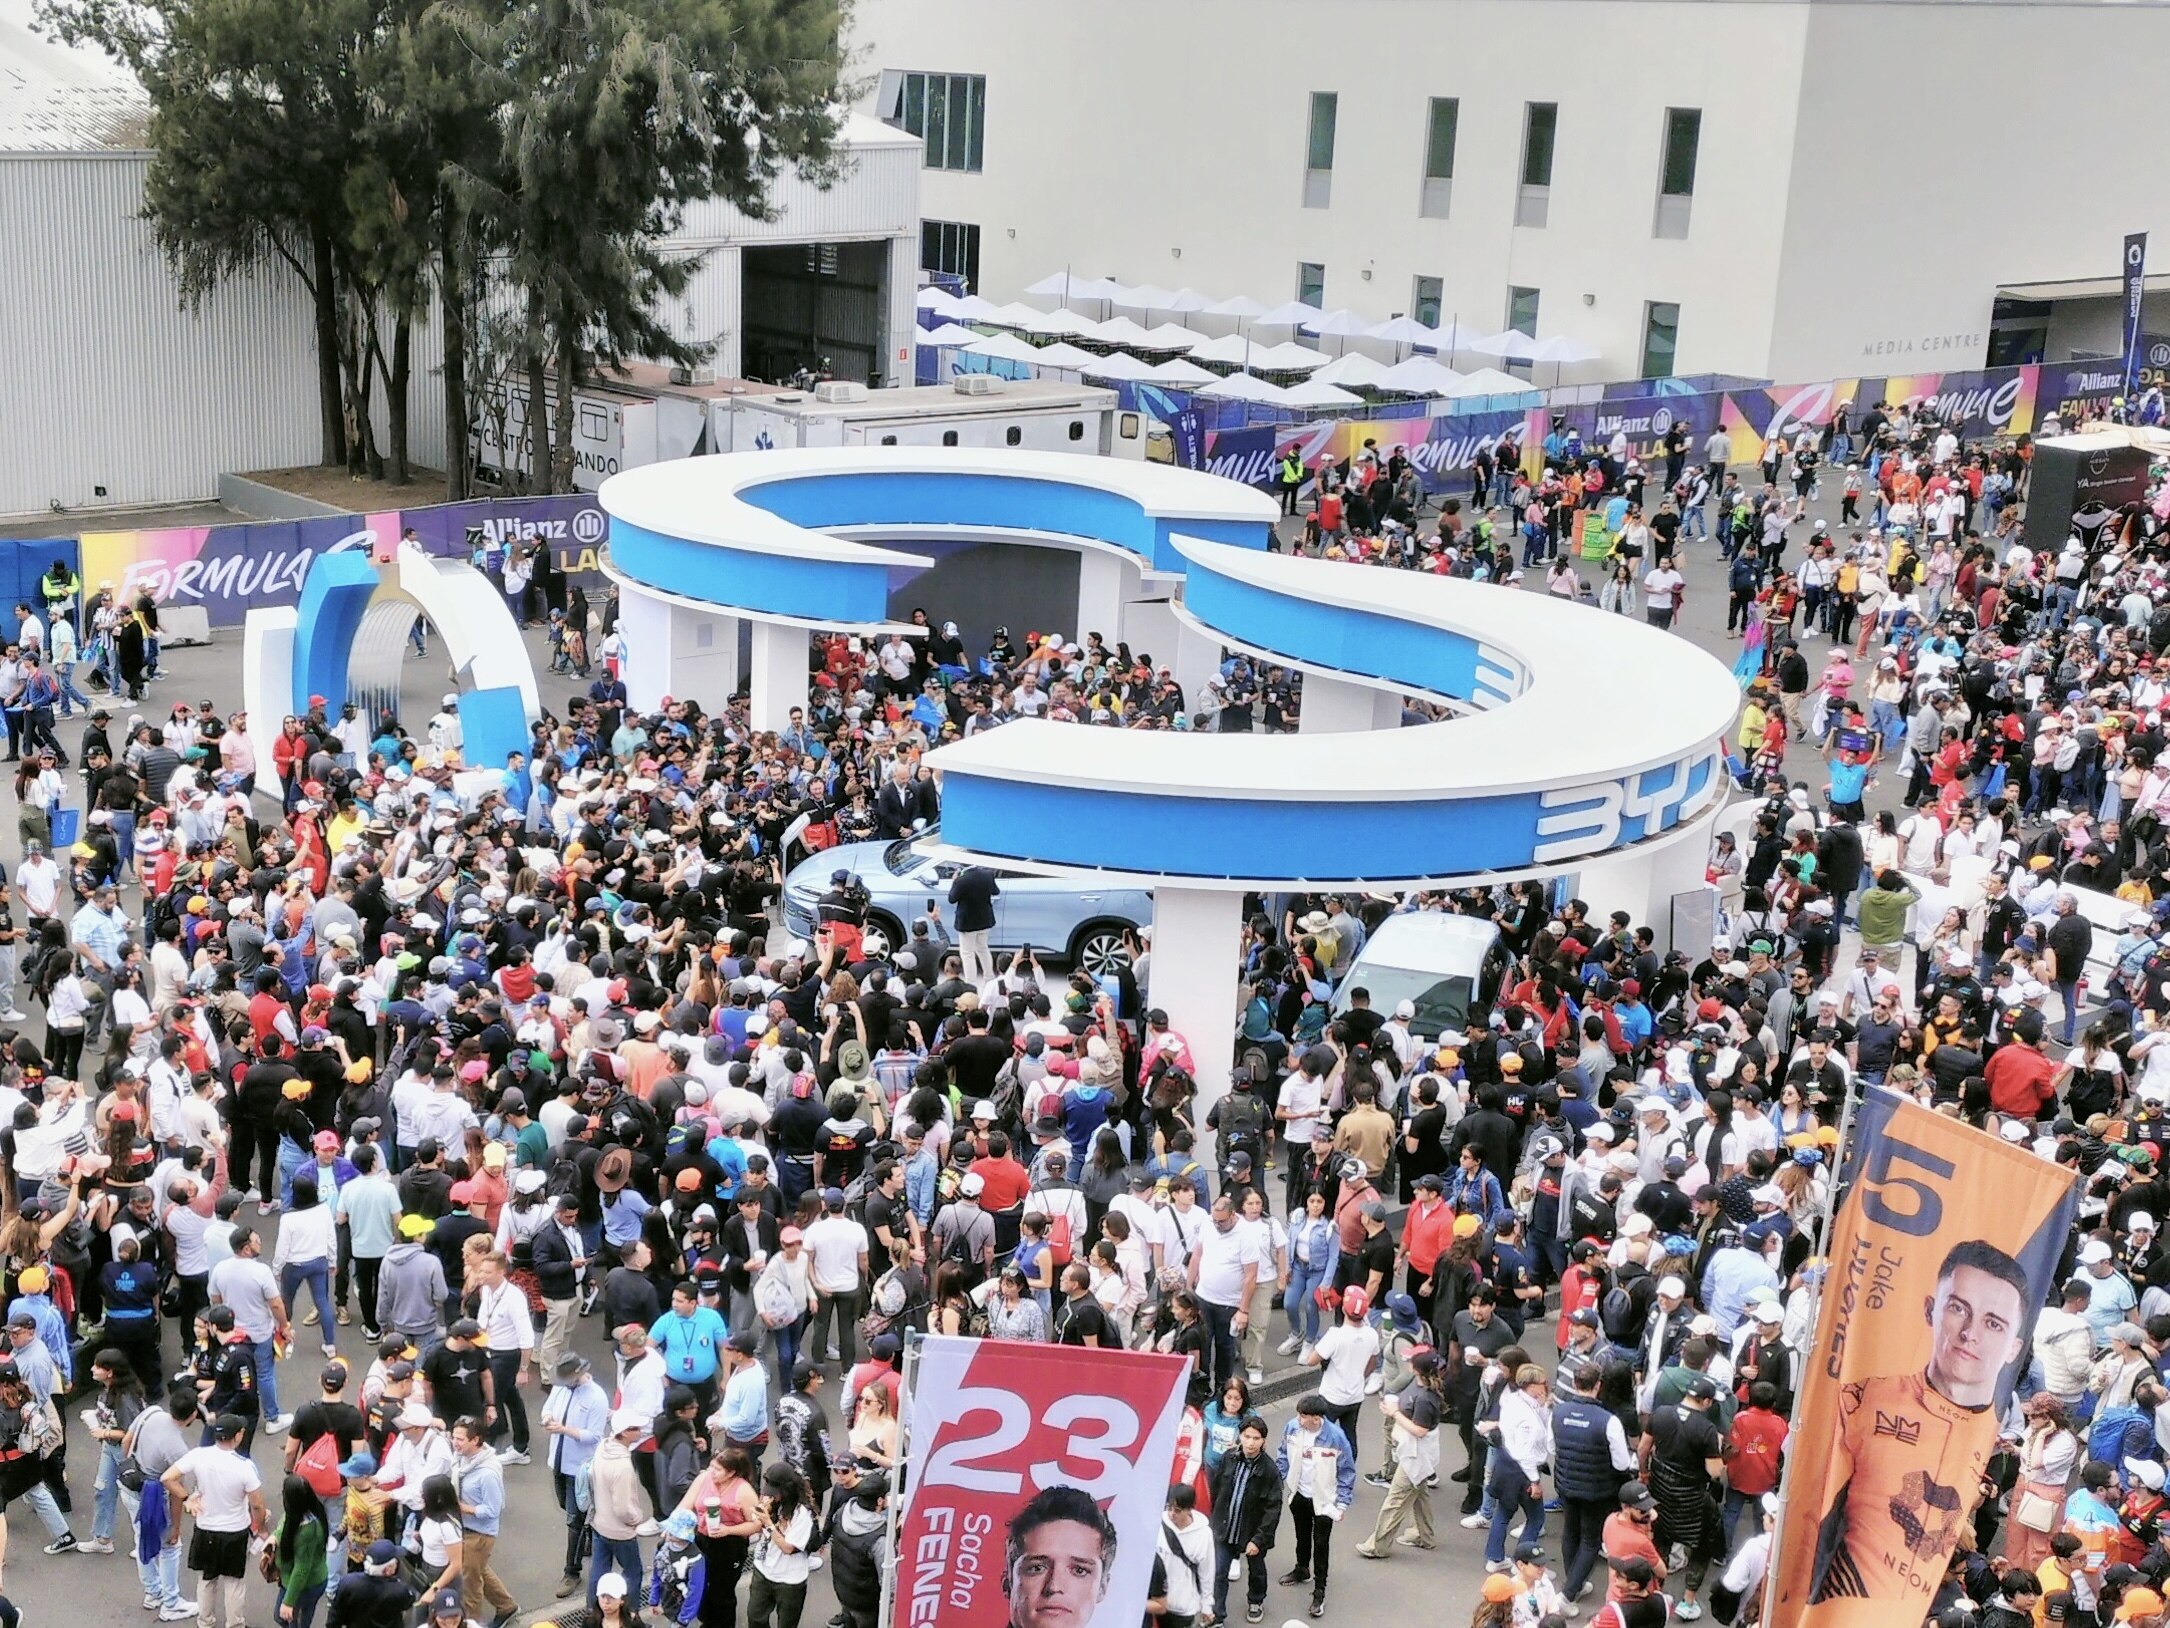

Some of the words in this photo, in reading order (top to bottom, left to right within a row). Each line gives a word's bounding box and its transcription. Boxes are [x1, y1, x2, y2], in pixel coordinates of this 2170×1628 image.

[1862, 338, 1913, 356] MEDIA
[1922, 333, 1982, 351] CENTRE
[2079, 372, 2122, 391] Allianz
[1595, 415, 1651, 436] Allianz
[574, 449, 619, 476] ANDO
[482, 517, 567, 543] Allianz
[1533, 750, 1723, 863] BYD
[1862, 1132, 1956, 1237] 5
[1865, 1246, 1903, 1311] Jake
[1939, 1405, 1969, 1422] NEOM
[923, 1387, 1140, 1500] 23
[910, 1507, 955, 1628] FENE
[950, 1512, 992, 1610] Sacha
[1884, 1552, 1932, 1597] NEOM
